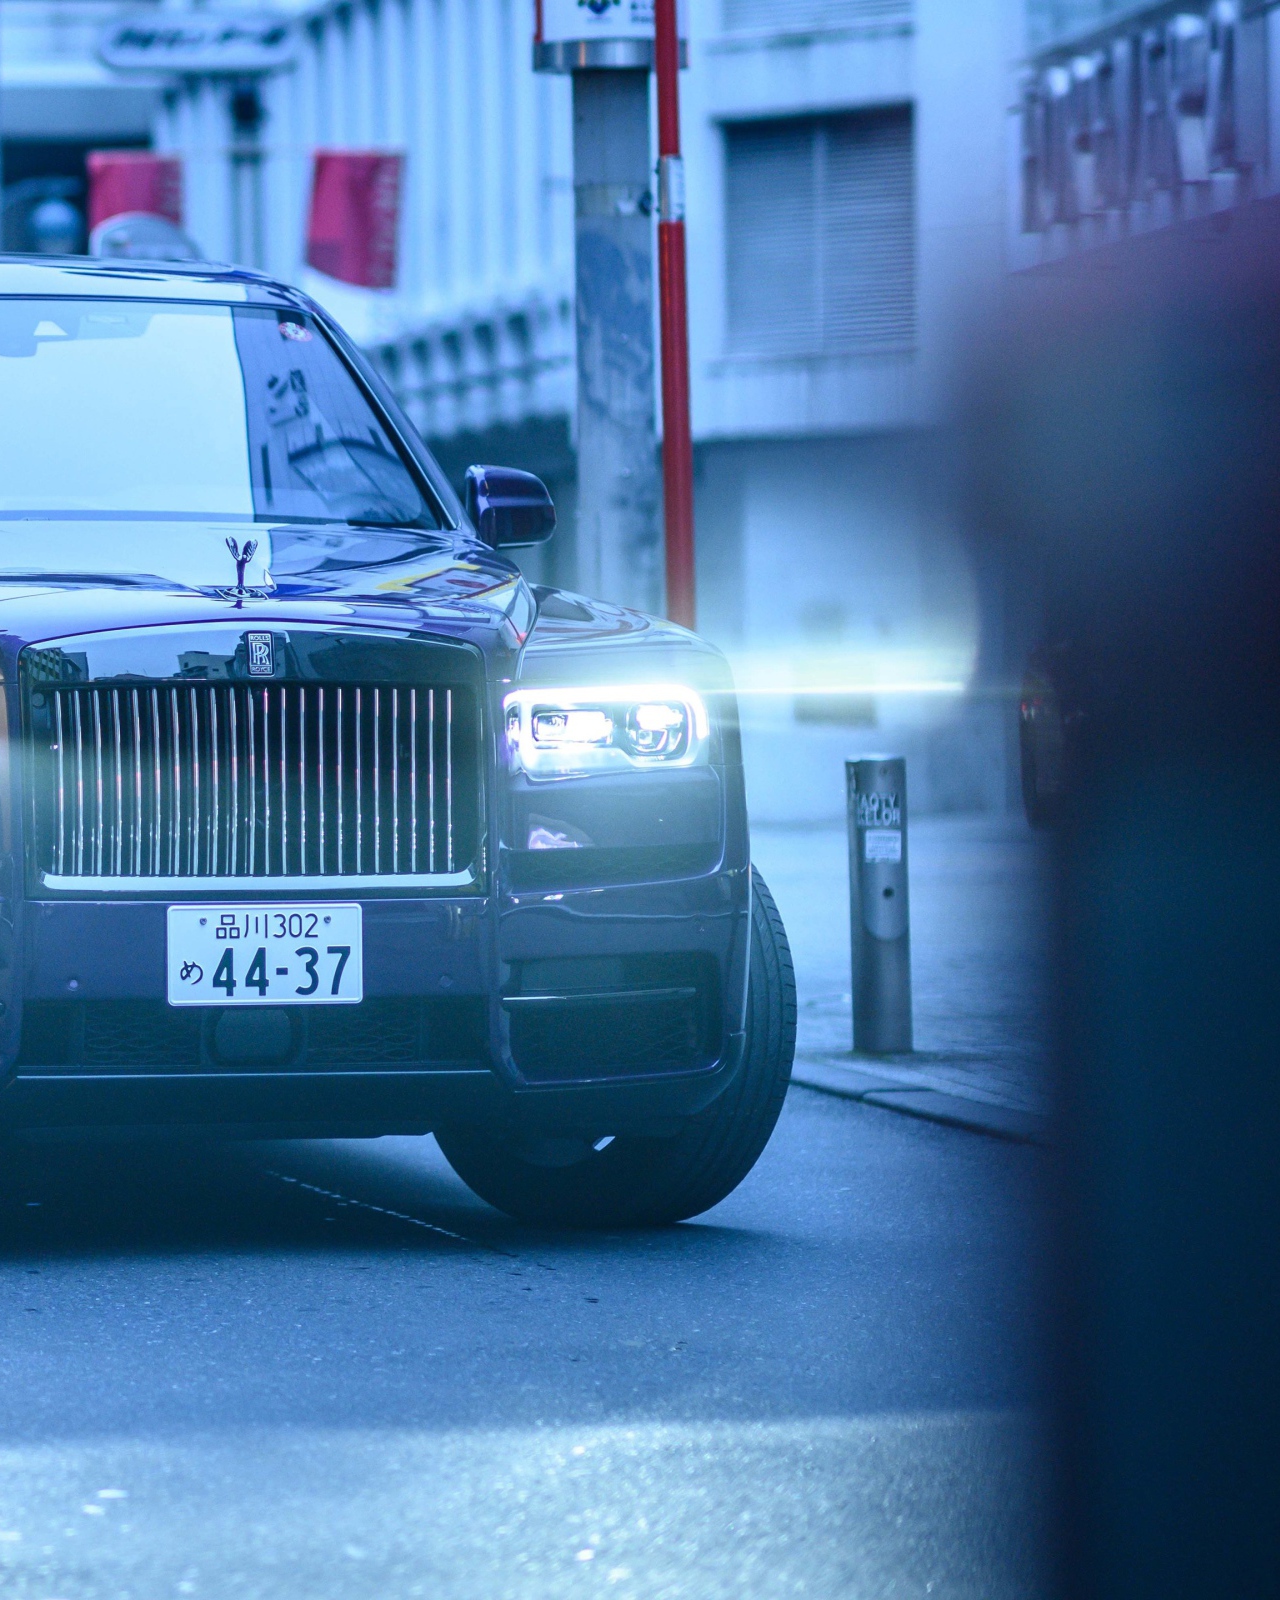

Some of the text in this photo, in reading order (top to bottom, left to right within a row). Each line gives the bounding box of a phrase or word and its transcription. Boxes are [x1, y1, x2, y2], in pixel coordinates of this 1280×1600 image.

[252, 642, 270, 665] RR
[179, 945, 351, 997] め 44-37
